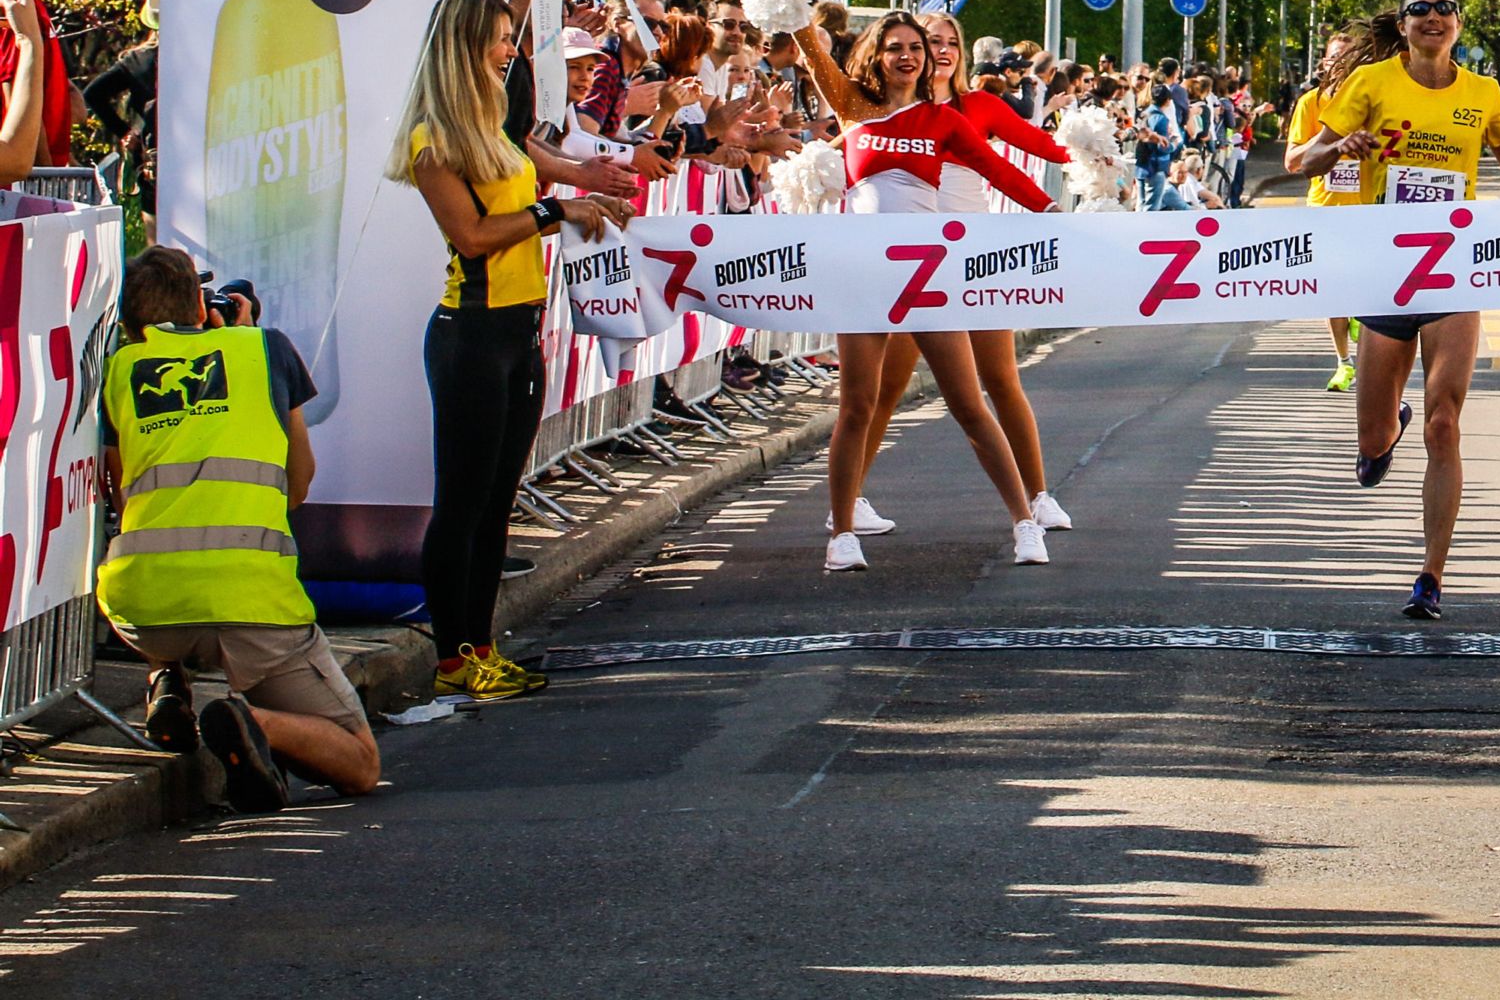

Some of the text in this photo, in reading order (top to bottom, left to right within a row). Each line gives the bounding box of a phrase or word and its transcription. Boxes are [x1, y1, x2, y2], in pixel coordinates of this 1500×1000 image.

[857, 133, 936, 156] SUISSE
[1408, 130, 1447, 143] ZÜRICH
[1405, 150, 1449, 163] CITYRUN
[1407, 142, 1463, 156] MARATHON
[1334, 170, 1359, 179] 7505
[1405, 185, 1446, 201] 7593
[965, 237, 1059, 281] BODYSTYLE
[1218, 232, 1313, 274] BODYSTYLE
[1286, 253, 1312, 268] SPORT
[563, 245, 630, 286] DYSTYLE
[714, 242, 807, 287] BODYSTYLE
[781, 266, 807, 283] SPORT
[1032, 260, 1059, 275] SPORT
[605, 270, 631, 286] SPORT
[1215, 278, 1318, 298] CITYRUN
[717, 292, 814, 312] CITYRUN
[962, 286, 1064, 306] CITYRUN
[574, 297, 638, 317] YRUN
[139, 402, 230, 435] sportoaf.com
[67, 455, 97, 514] CITYRU
